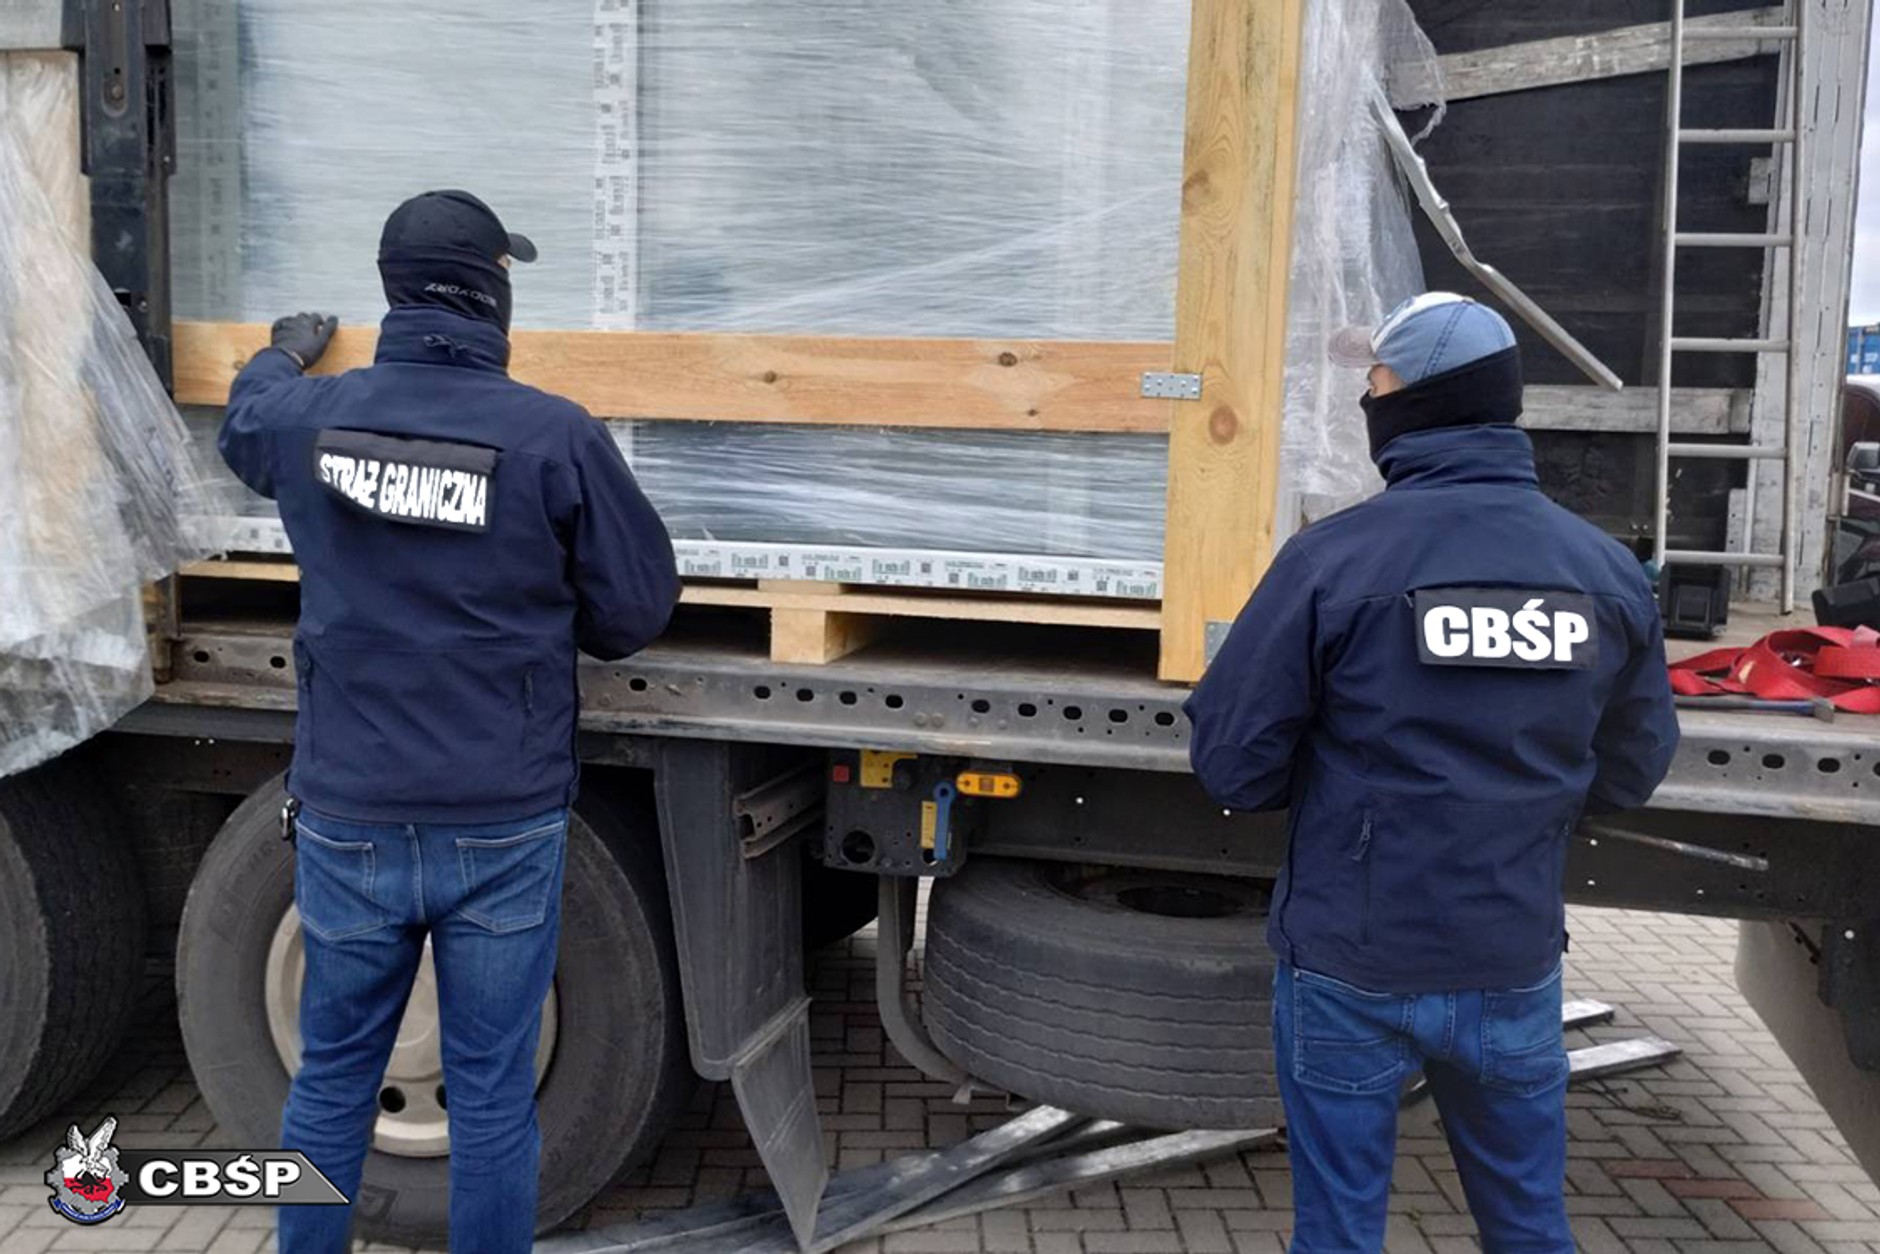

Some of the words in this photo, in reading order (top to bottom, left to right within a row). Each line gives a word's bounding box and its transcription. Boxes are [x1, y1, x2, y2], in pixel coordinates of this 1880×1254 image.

[319, 453, 380, 509] STRAŻ
[379, 462, 488, 526] GRANICZNA
[1423, 598, 1589, 662] CBŚP
